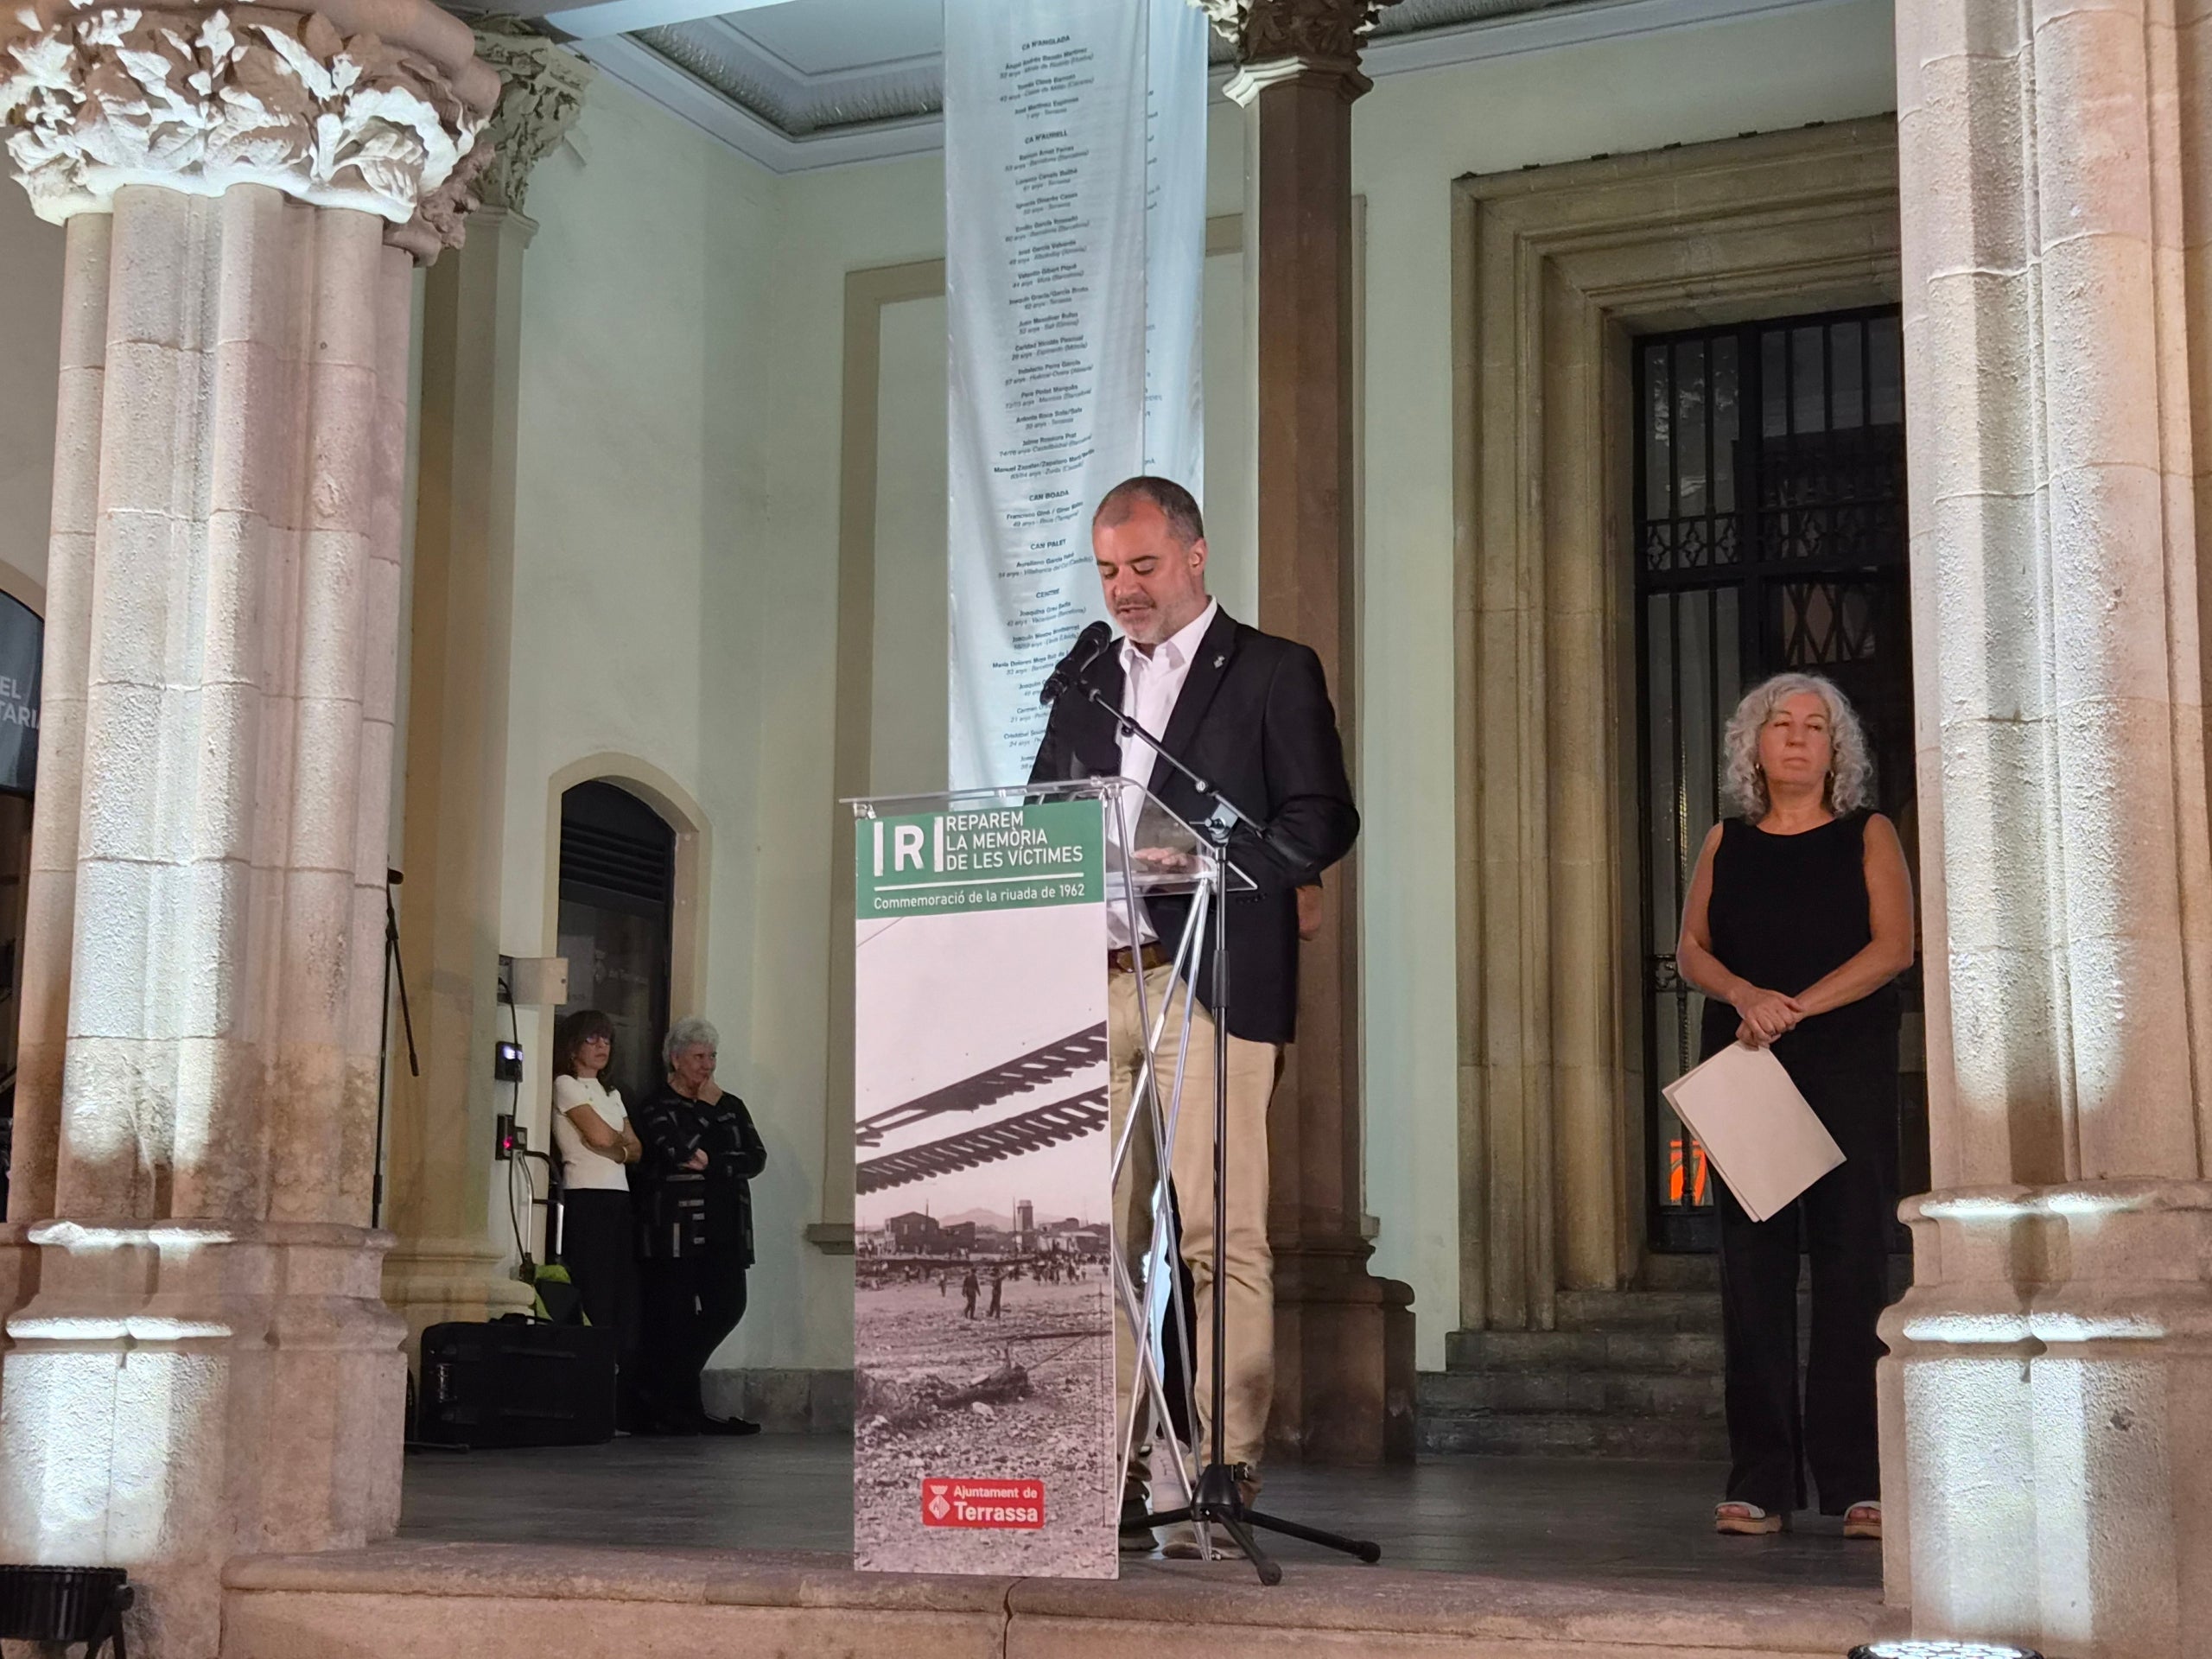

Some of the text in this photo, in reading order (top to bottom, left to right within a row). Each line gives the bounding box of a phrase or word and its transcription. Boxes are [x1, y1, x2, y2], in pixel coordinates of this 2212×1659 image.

[1045, 489, 1070, 499] BOADA
[1047, 538, 1066, 548] PALET
[946, 810, 1024, 832] REPAREM
[946, 827, 1048, 851] LA MEMÒRIA
[946, 845, 1084, 871] DE LES VÍCTIMES
[874, 884, 1084, 910] Commemoració de la riuada de 1962
[953, 1485, 1038, 1499] Ajuntament de
[954, 1501, 1039, 1522] Terrassa
